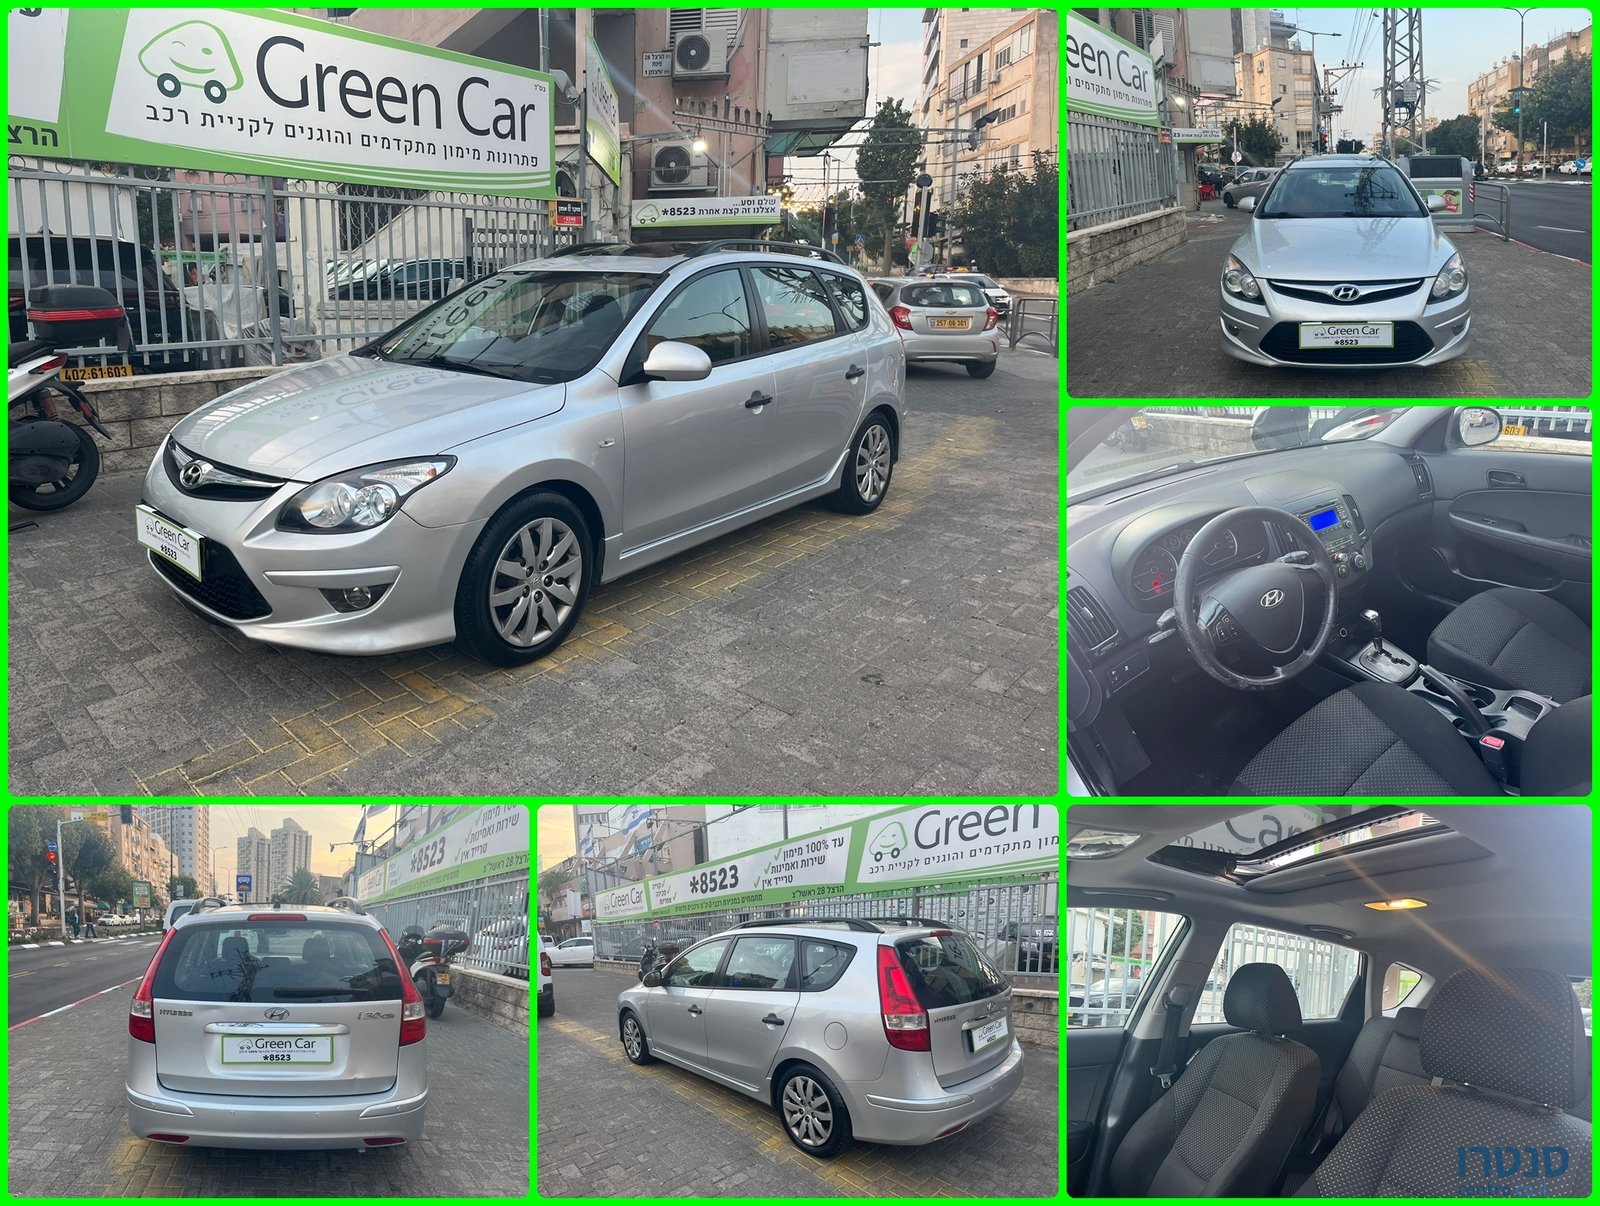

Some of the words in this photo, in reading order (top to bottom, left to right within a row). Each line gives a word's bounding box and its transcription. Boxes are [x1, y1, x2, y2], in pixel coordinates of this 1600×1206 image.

[1116, 50, 1149, 92] Car
[256, 35, 442, 130] Green
[457, 77, 535, 142] Car
[1075, 78, 1110, 96] מתקדמים
[1112, 89, 1130, 102] מימון
[1131, 95, 1152, 108] פתרונות
[146, 105, 189, 125] רכב
[201, 113, 274, 137] לקניית
[285, 124, 352, 146] והוגנים
[361, 134, 436, 155] מתקדמים
[443, 144, 481, 160] מימון
[487, 150, 538, 167] פתרונות
[758, 198, 776, 206] שלם
[722, 208, 740, 216] קצת
[752, 206, 776, 214] אצלנו
[1328, 326, 1360, 336] Green
[1361, 326, 1380, 336] Car
[155, 520, 177, 544] Green
[178, 533, 190, 552] Car
[495, 813, 520, 834] שירות
[914, 804, 1040, 850] Green
[470, 824, 494, 844] ואמינות
[806, 840, 829, 854] 100%
[832, 836, 844, 848] עד
[969, 840, 1031, 857] מתקדמים
[460, 850, 470, 864] אין
[471, 843, 488, 858] טרייד
[783, 846, 803, 862] מימון
[506, 856, 514, 868] 28
[800, 854, 826, 868] שירות
[888, 858, 920, 872] לקניית
[924, 851, 964, 866] והוגנים
[770, 860, 798, 874] ואמינות
[869, 864, 884, 874] רכב
[762, 878, 772, 890] אין
[774, 874, 794, 886] טרייד
[816, 887, 826, 895] 28
[827, 885, 844, 894] הרצל
[610, 892, 630, 908] Green
[630, 888, 644, 904] Car
[254, 1038, 292, 1049] Green
[294, 1038, 316, 1049] Car
